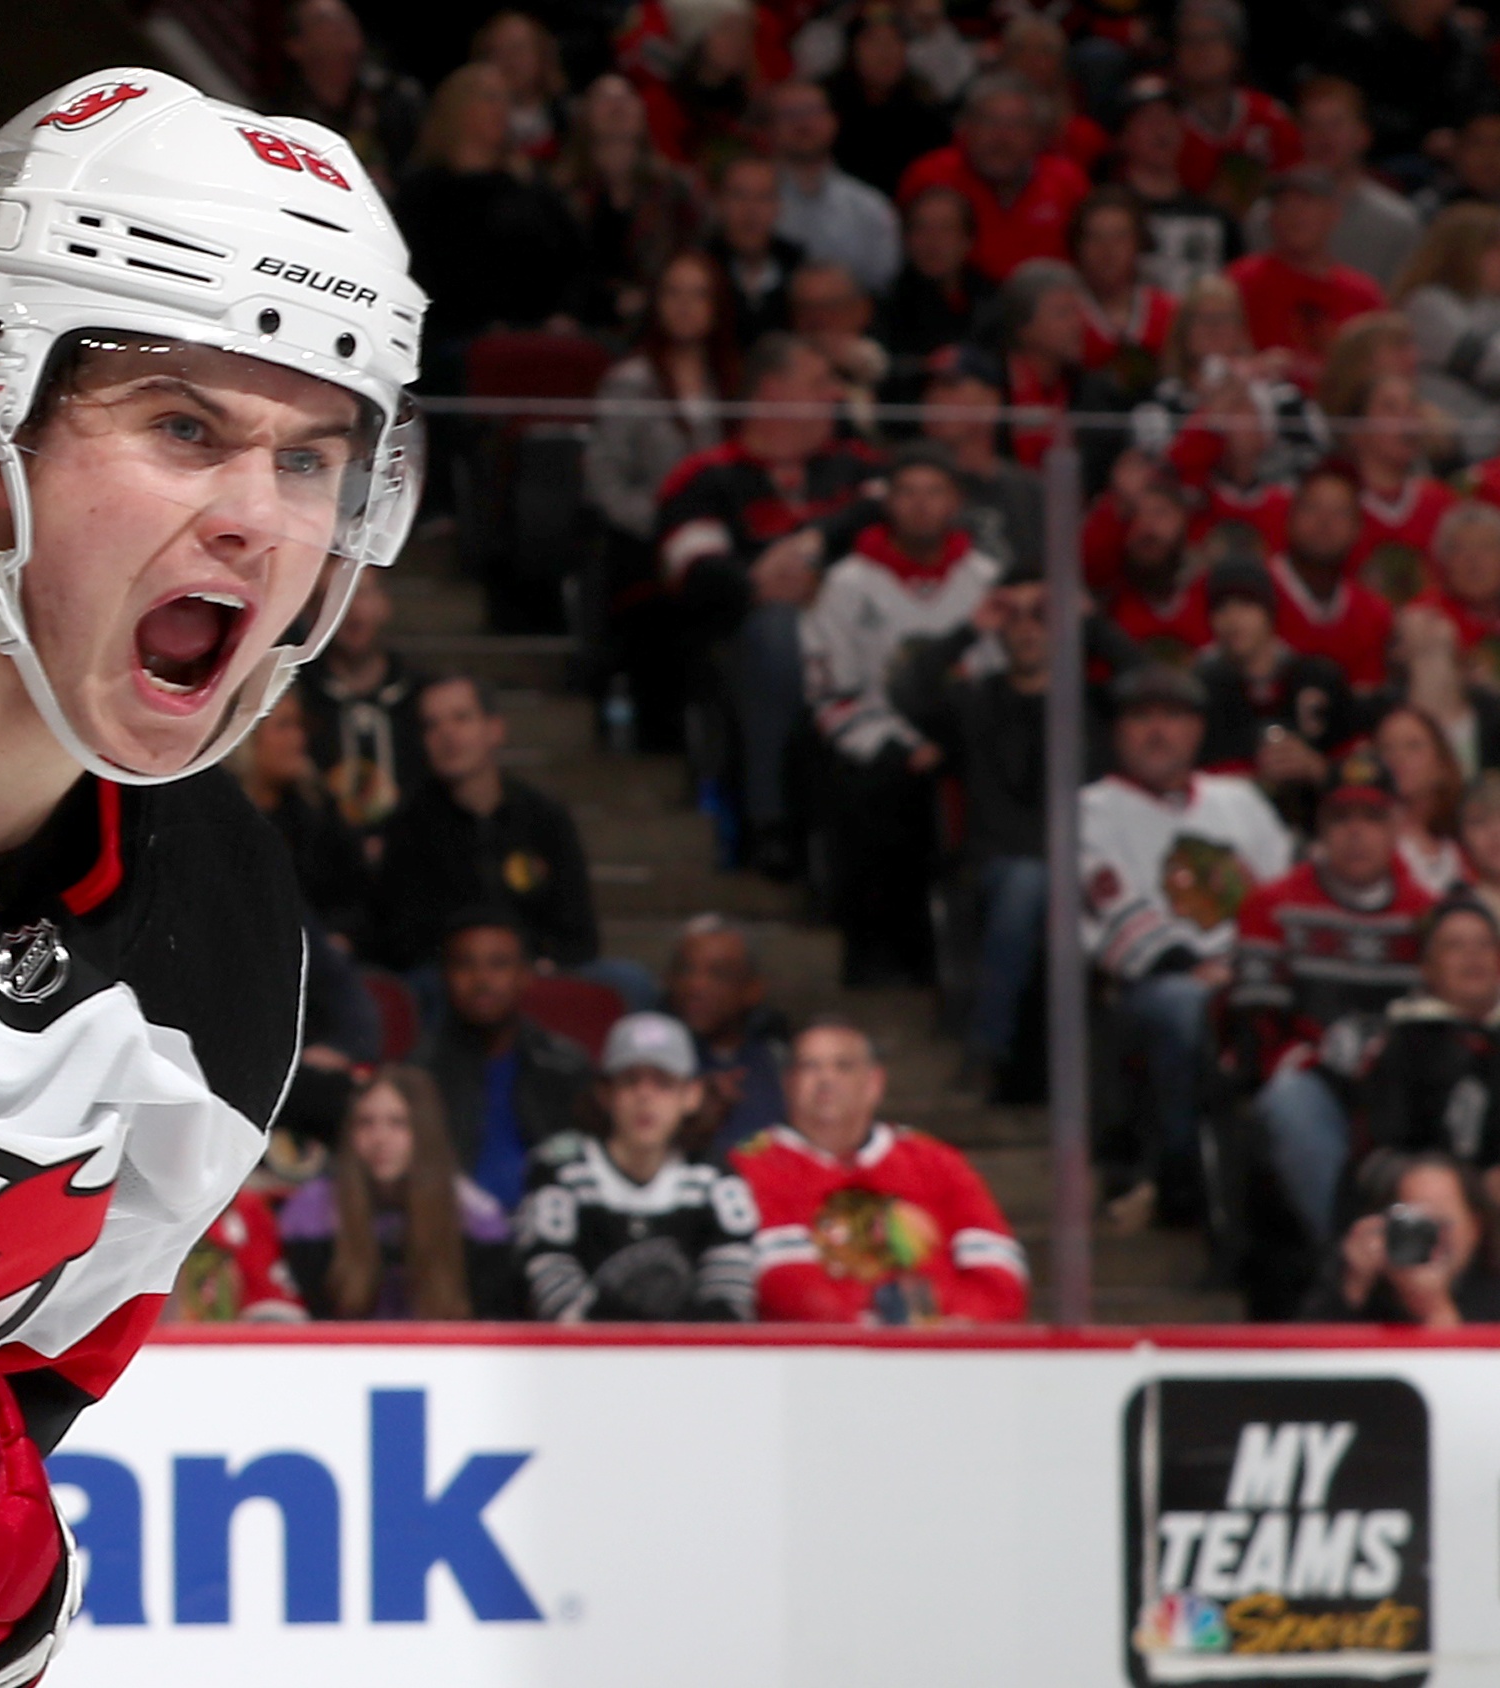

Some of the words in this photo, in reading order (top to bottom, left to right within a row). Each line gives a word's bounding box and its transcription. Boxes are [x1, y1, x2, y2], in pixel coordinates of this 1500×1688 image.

[253, 255, 380, 309] BAUER
[1227, 1420, 1357, 1508] MY
[1159, 1508, 1412, 1600] TEAMS
